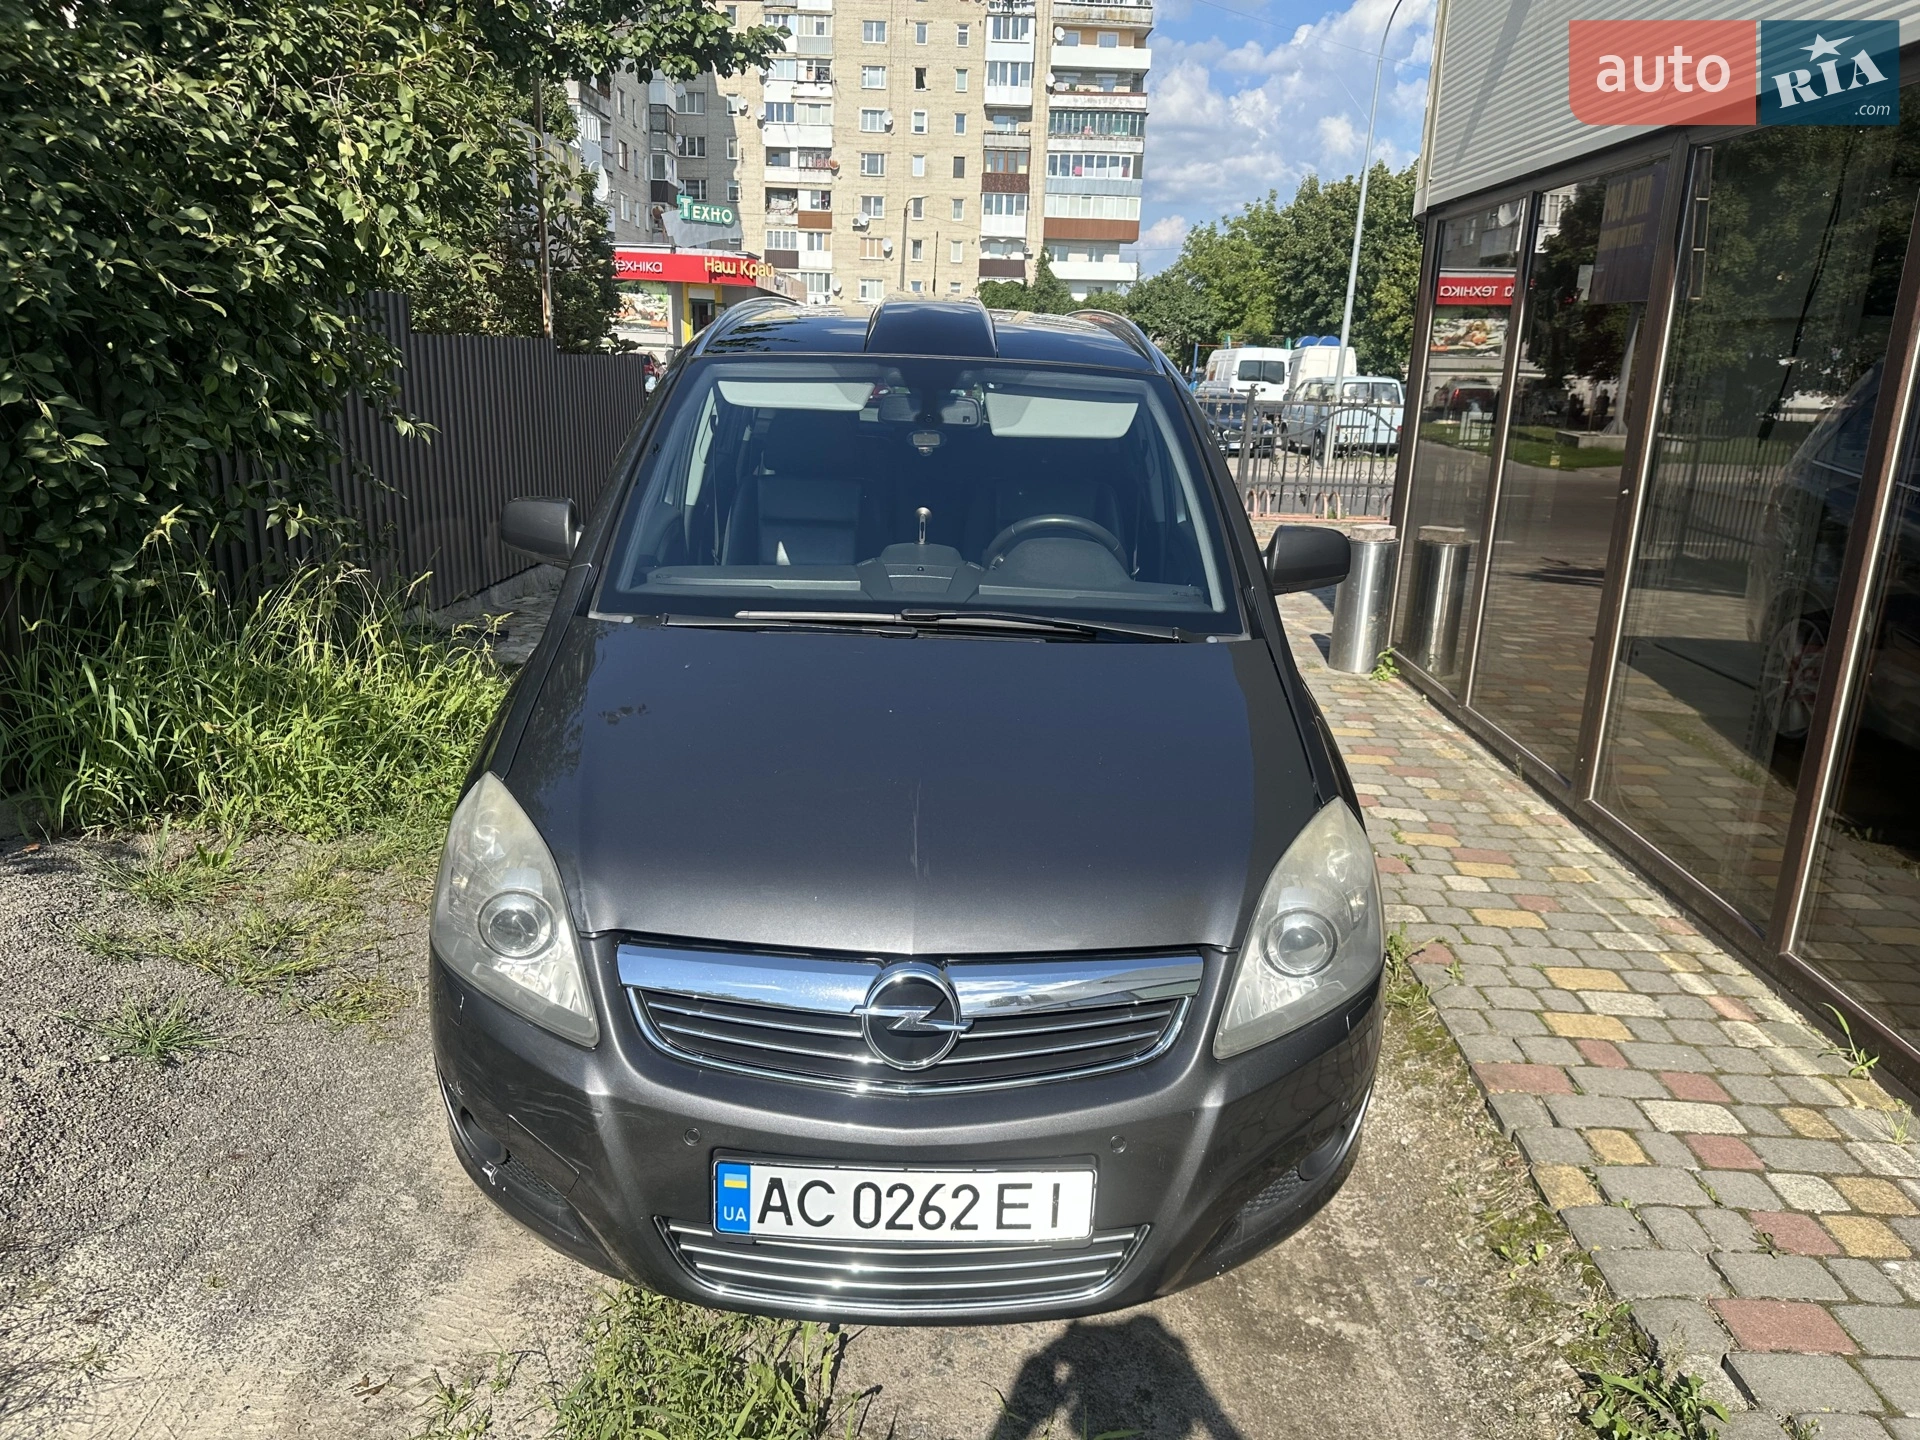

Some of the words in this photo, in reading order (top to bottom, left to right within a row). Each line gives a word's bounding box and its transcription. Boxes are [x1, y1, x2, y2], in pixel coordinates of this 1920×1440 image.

[704, 256, 737, 275] Наш
[740, 259, 774, 278] Край
[724, 1205, 747, 1222] UA
[757, 1177, 836, 1227] AC
[853, 1181, 980, 1231] 0262
[996, 1182, 1060, 1230] EI
